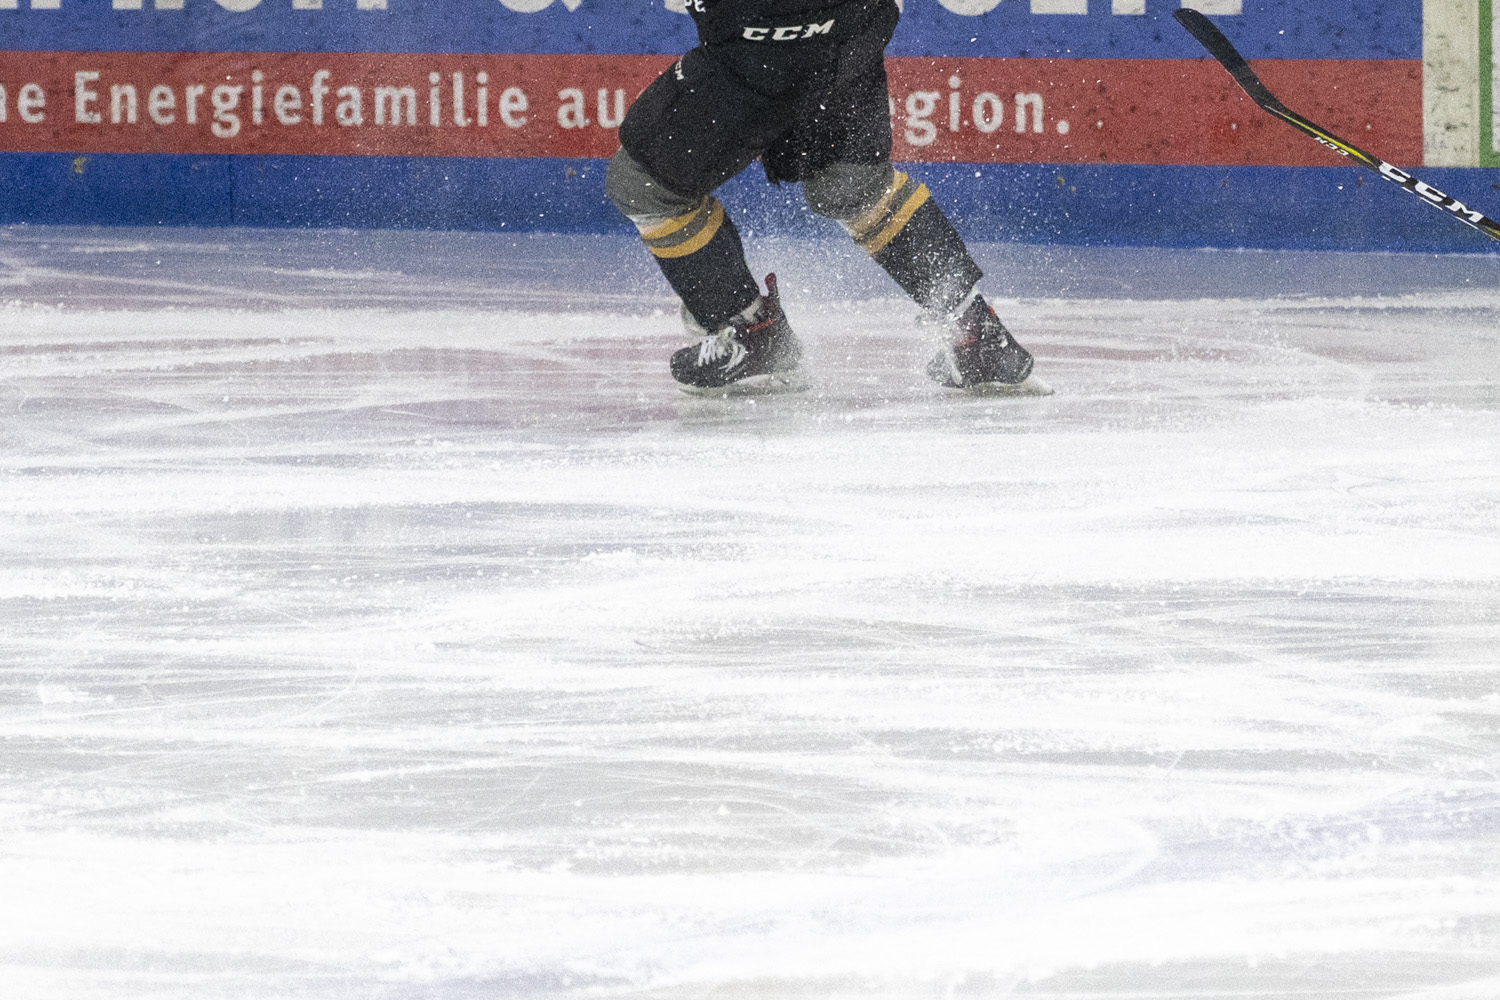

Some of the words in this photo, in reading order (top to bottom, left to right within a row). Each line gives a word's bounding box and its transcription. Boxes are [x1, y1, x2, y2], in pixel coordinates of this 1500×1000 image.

[743, 19, 836, 41] CCM
[674, 61, 685, 81] CM
[75, 71, 528, 138] Energiefamilie
[557, 87, 626, 129] au
[889, 76, 1070, 146] gion.
[1378, 160, 1484, 224] CCM
